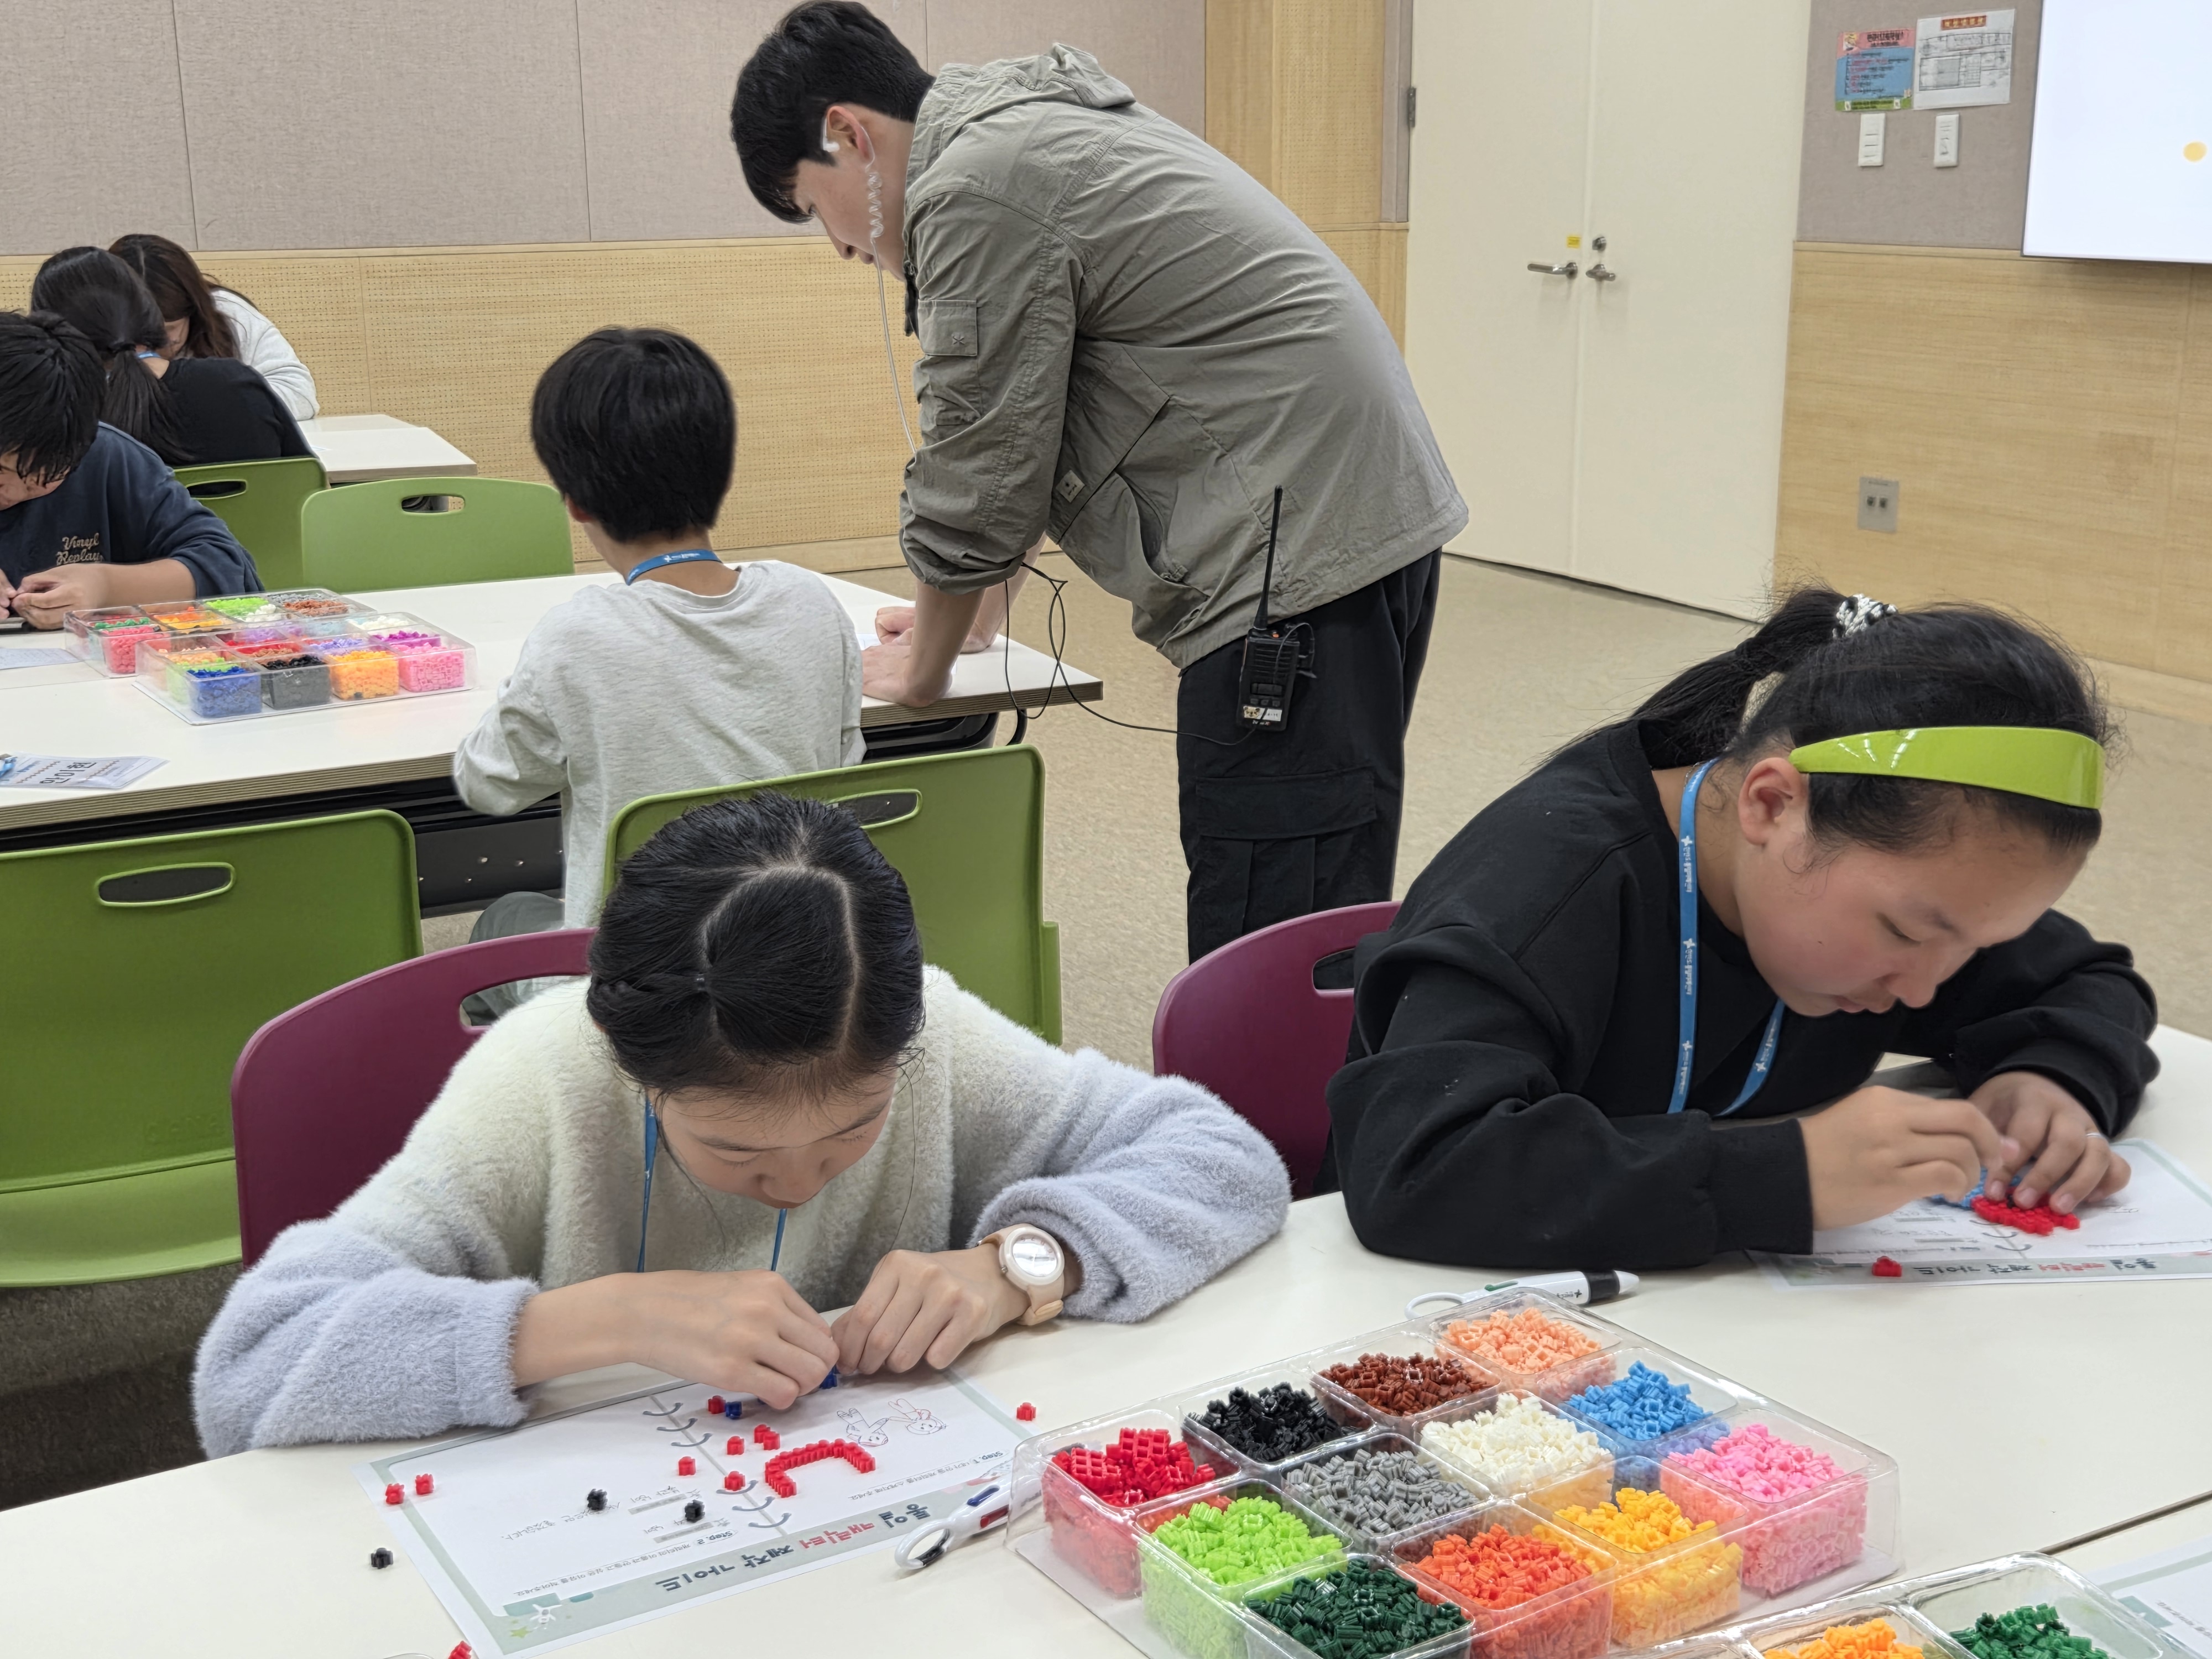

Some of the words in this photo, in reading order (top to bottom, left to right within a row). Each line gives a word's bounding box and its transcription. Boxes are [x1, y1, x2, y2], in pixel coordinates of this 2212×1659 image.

[62, 533, 100, 550] Vinyl
[1912, 1265, 1981, 1275] 가이드
[878, 1503, 932, 1528] 통일
[706, 1531, 733, 1541] Step.
[798, 1521, 875, 1549] 캐릭터
[740, 1545, 795, 1568] 제작
[655, 1563, 736, 1592] 가이드
